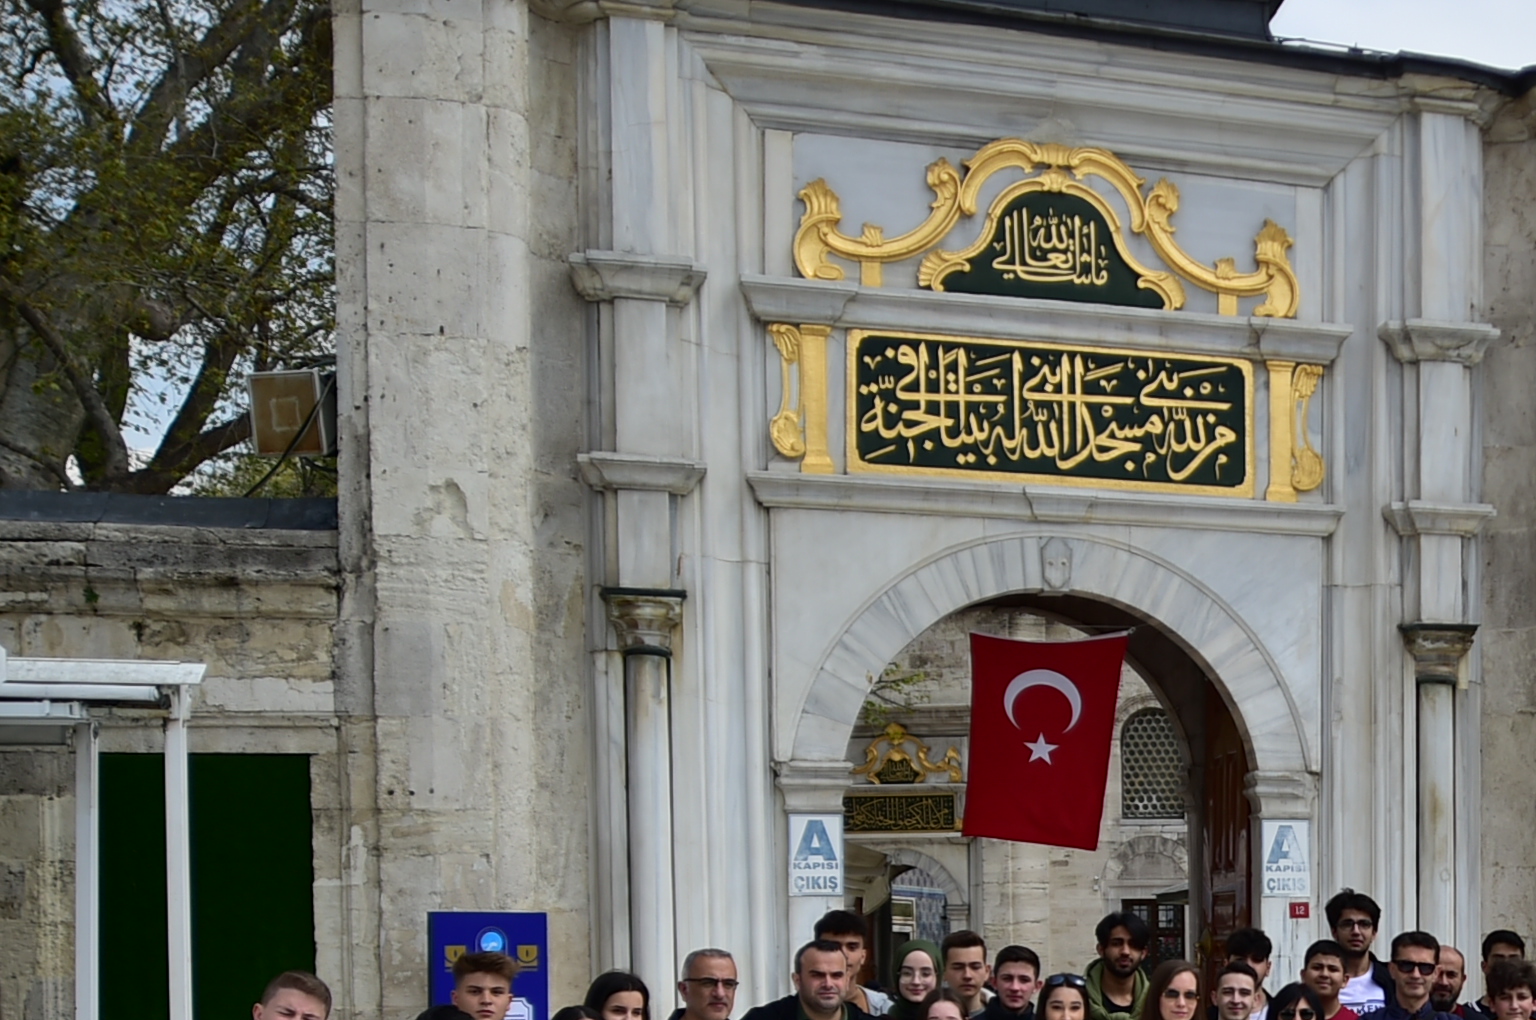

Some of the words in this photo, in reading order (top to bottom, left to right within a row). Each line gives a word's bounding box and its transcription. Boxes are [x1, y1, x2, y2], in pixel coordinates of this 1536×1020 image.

[794, 819, 838, 861] A
[1266, 824, 1306, 864] A
[793, 862, 839, 870] KAPISI
[1265, 865, 1307, 873] KAPISI
[793, 875, 838, 893] ÇIKIŞ
[1295, 905, 1305, 915] 12
